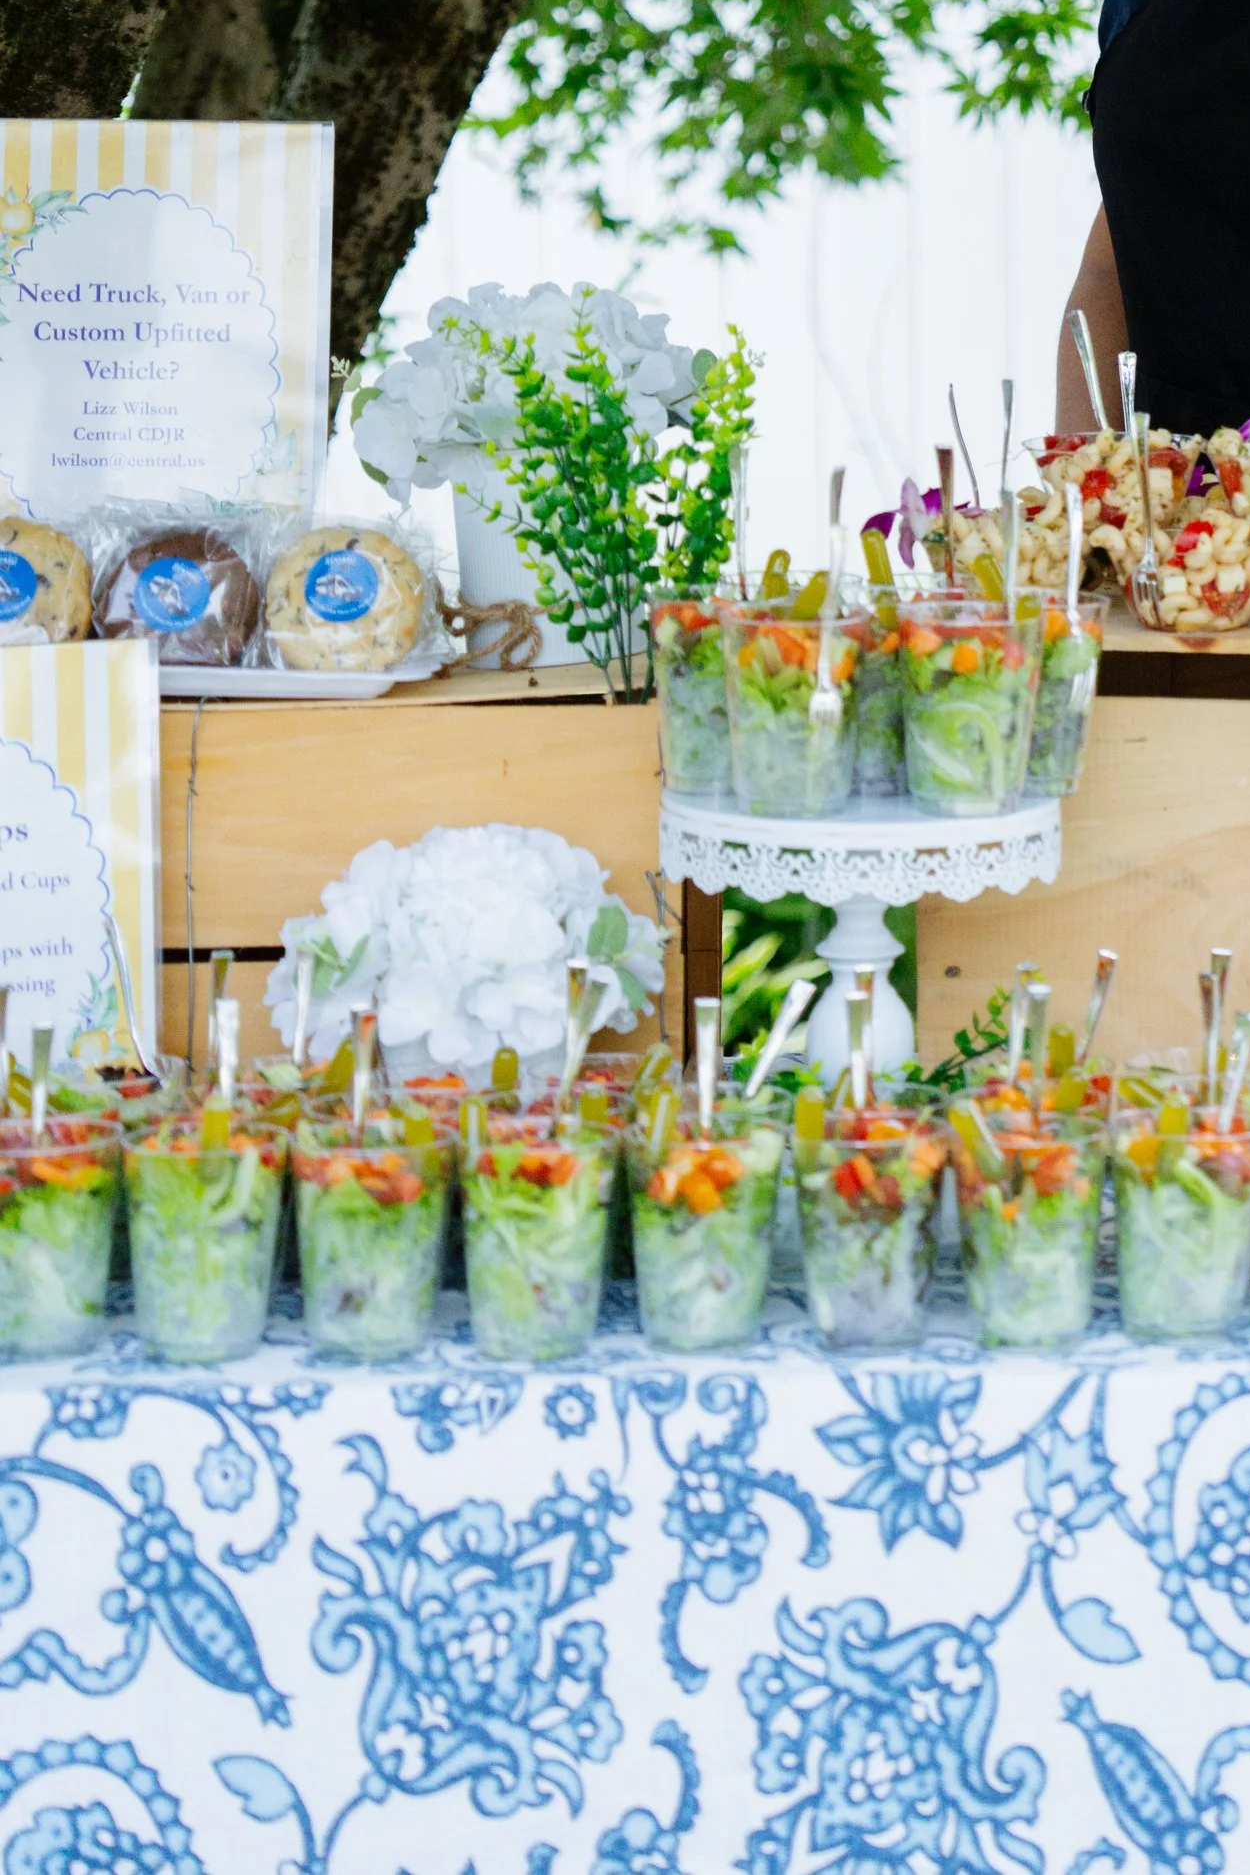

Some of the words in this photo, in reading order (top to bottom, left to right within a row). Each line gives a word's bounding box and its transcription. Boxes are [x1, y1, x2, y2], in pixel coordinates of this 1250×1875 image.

[17, 283, 81, 303] Need
[88, 283, 168, 306] Truck,
[174, 284, 218, 304] Van
[226, 290, 251, 304] or
[33, 322, 126, 342] Custom
[134, 323, 231, 347] Upfitted
[83, 360, 180, 380] Vehicle?
[82, 401, 117, 415] Lizz
[122, 401, 178, 415] Wilson
[73, 427, 133, 441] Central
[137, 427, 185, 445] CDJR
[51, 453, 206, 468] lwilson@central.us
[21, 872, 71, 894] Cups
[29, 936, 73, 957] with
